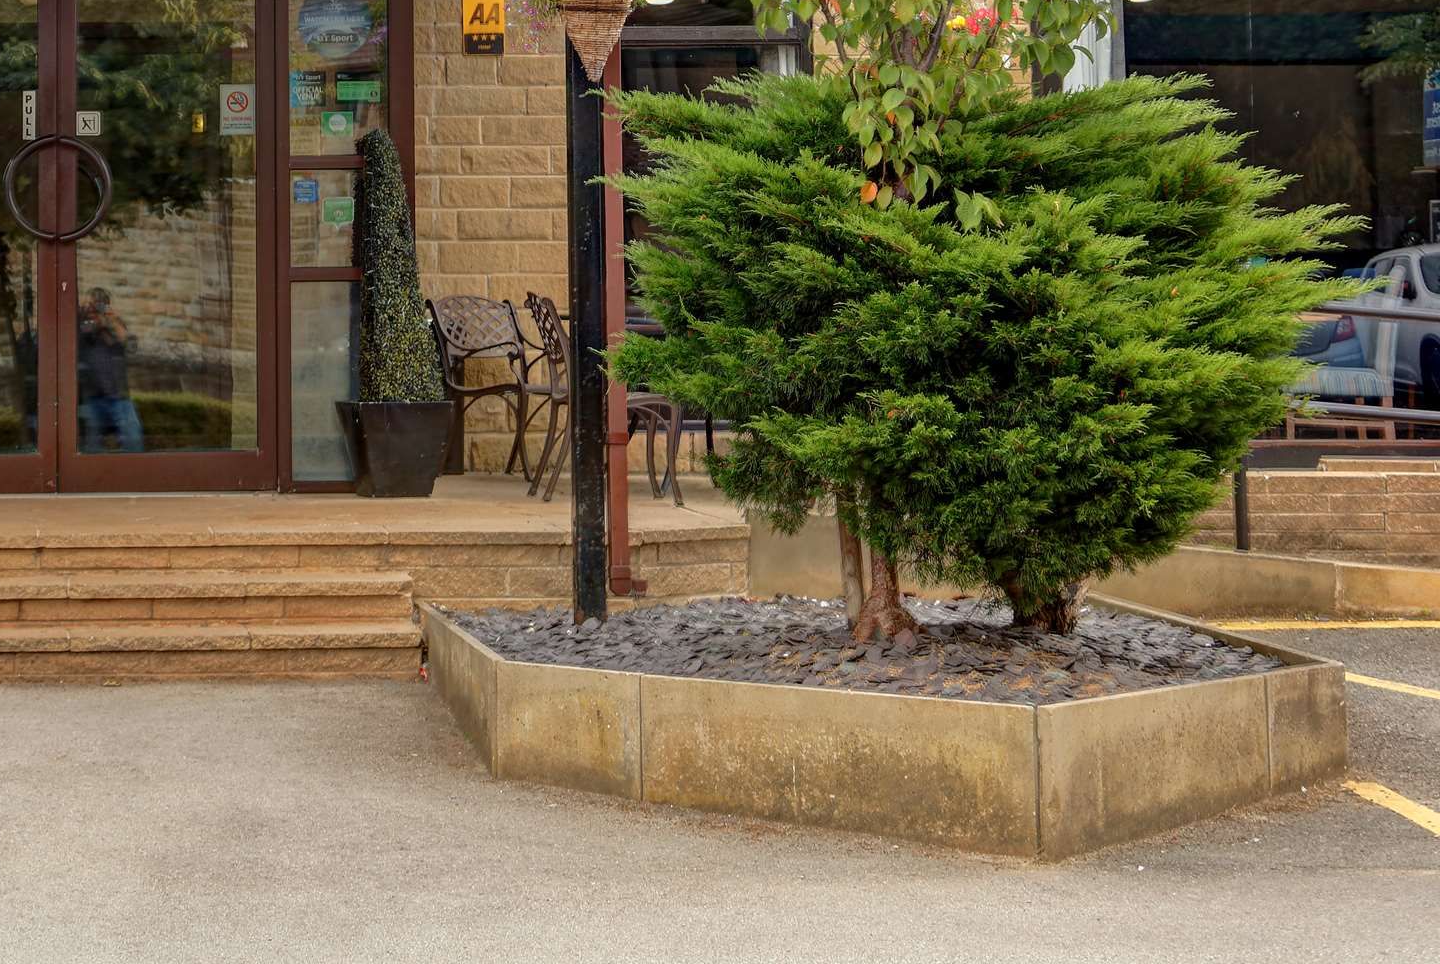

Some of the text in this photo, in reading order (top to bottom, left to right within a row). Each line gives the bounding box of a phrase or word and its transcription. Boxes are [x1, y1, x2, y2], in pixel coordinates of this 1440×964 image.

[469, 2, 500, 25] AA
[330, 34, 353, 44] Sport
[25, 94, 33, 137] PULL
